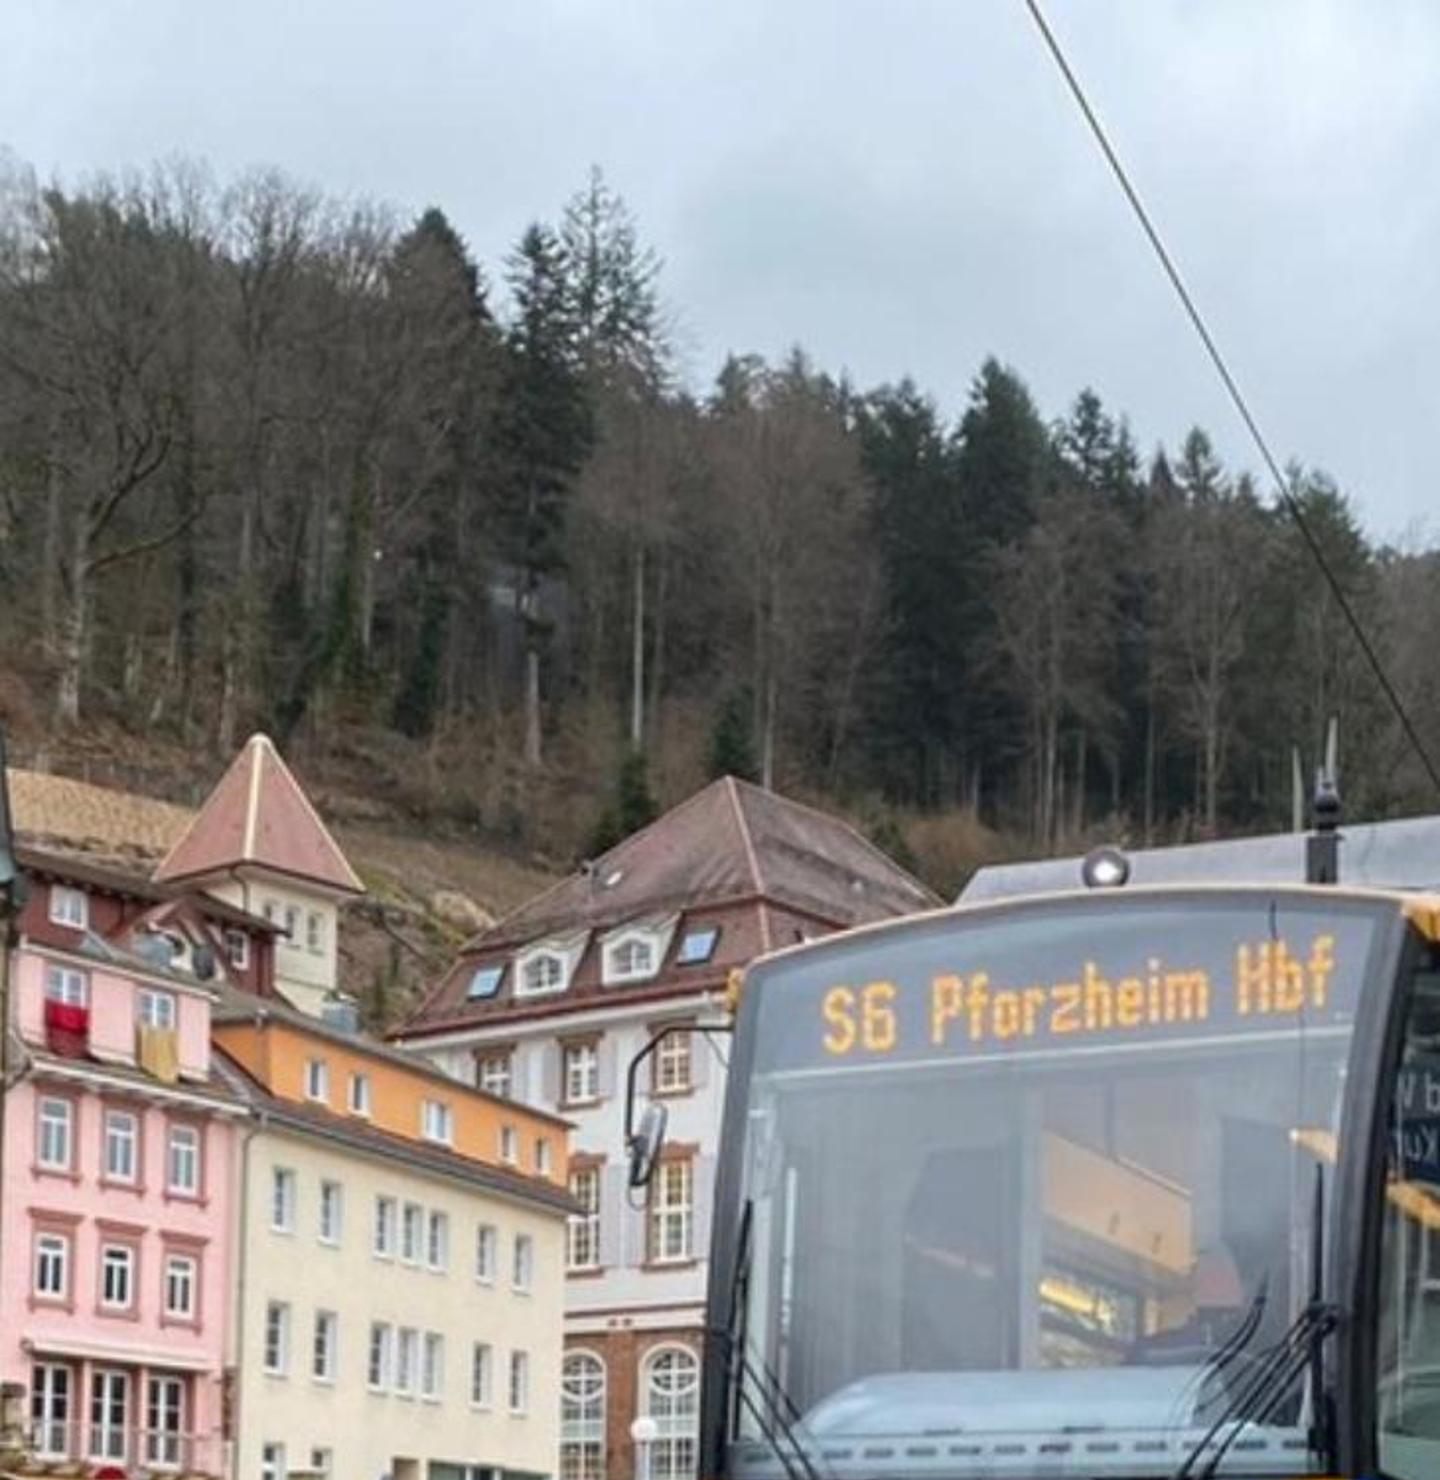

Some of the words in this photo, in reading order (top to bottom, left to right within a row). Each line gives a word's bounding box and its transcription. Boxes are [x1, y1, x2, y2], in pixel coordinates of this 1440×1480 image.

[822, 982, 897, 1055] S6
[931, 959, 1210, 1043] Pforzheim
[1236, 934, 1336, 1016] Hbf
